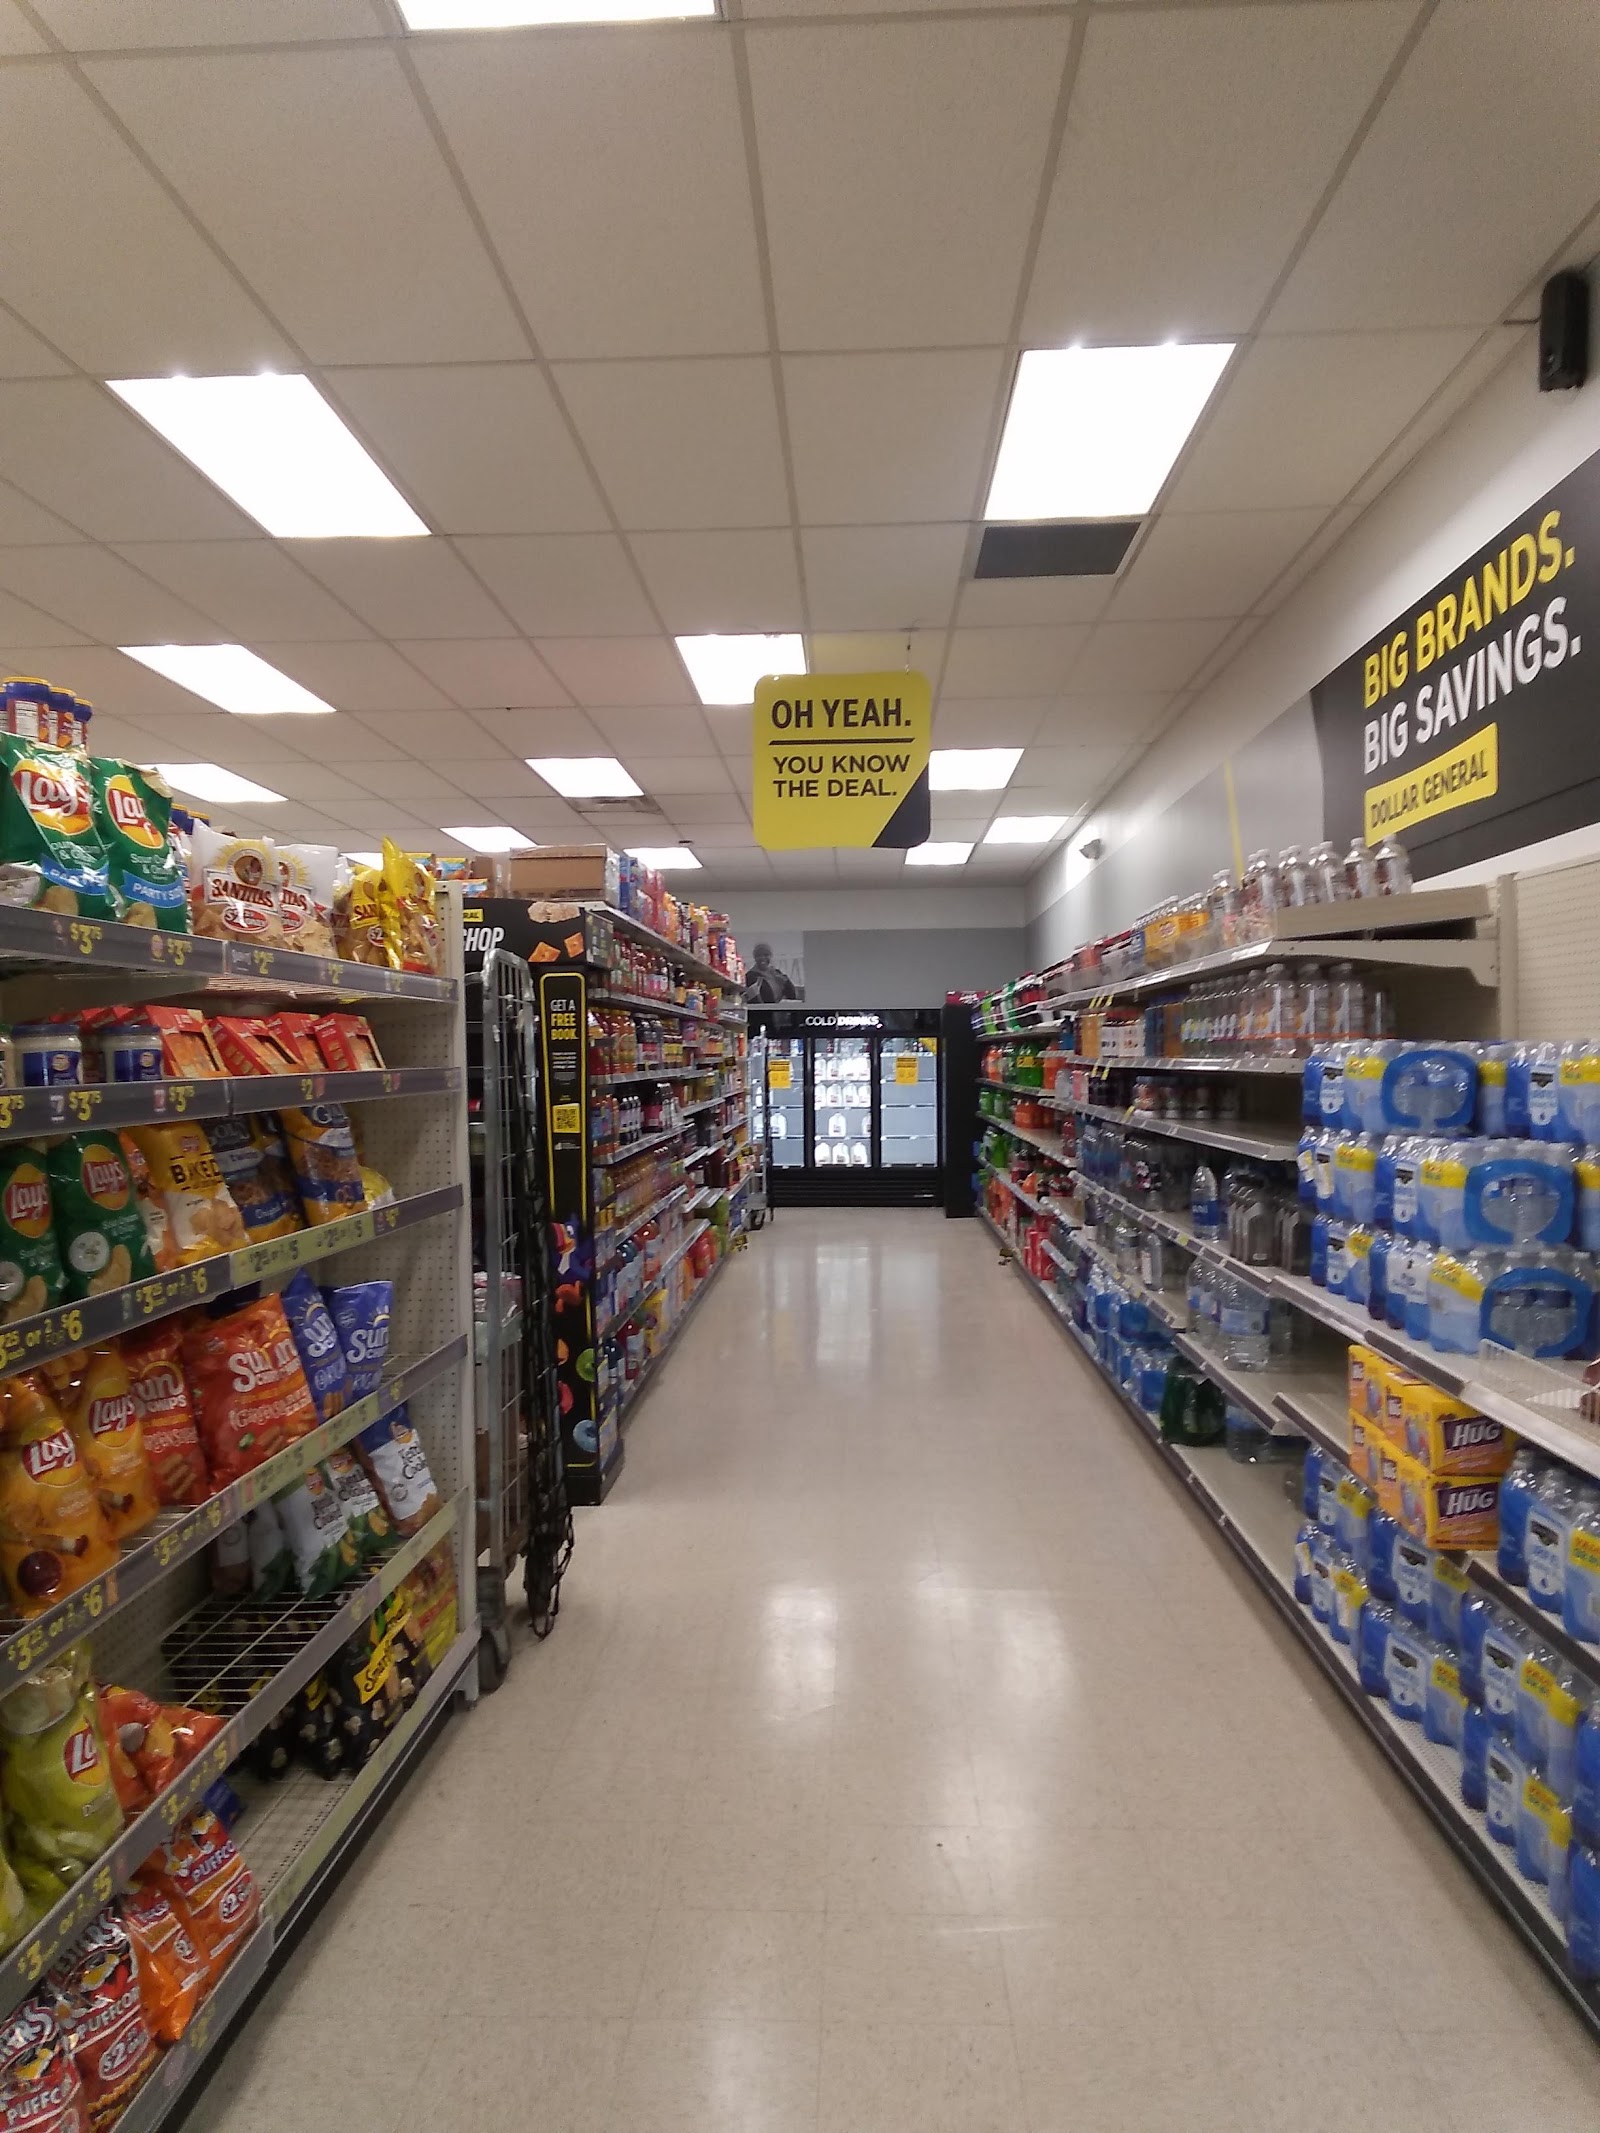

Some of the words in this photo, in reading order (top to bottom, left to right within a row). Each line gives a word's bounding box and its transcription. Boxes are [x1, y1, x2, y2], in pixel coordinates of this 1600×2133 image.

[1364, 631, 1409, 710] BIG
[1415, 509, 1576, 673] BRANDS.
[1364, 700, 1409, 776] BIG
[1415, 596, 1582, 745] SAVINGS.
[771, 699, 813, 729] OH
[821, 698, 912, 728] YEAH.
[773, 756, 823, 774] YOU
[832, 754, 911, 773] KNOW
[773, 780, 820, 798] THE
[827, 778, 897, 797] DEAL.
[1370, 780, 1419, 829] DOLLAR
[1422, 748, 1490, 804] GENERAL
[550, 999, 568, 1012] GET
[568, 999, 576, 1011] A
[550, 1012, 577, 1027] FREE
[805, 1015, 836, 1026] COLD
[25, 1329, 42, 1348] or
[1446, 1491, 1494, 1517] HUG
